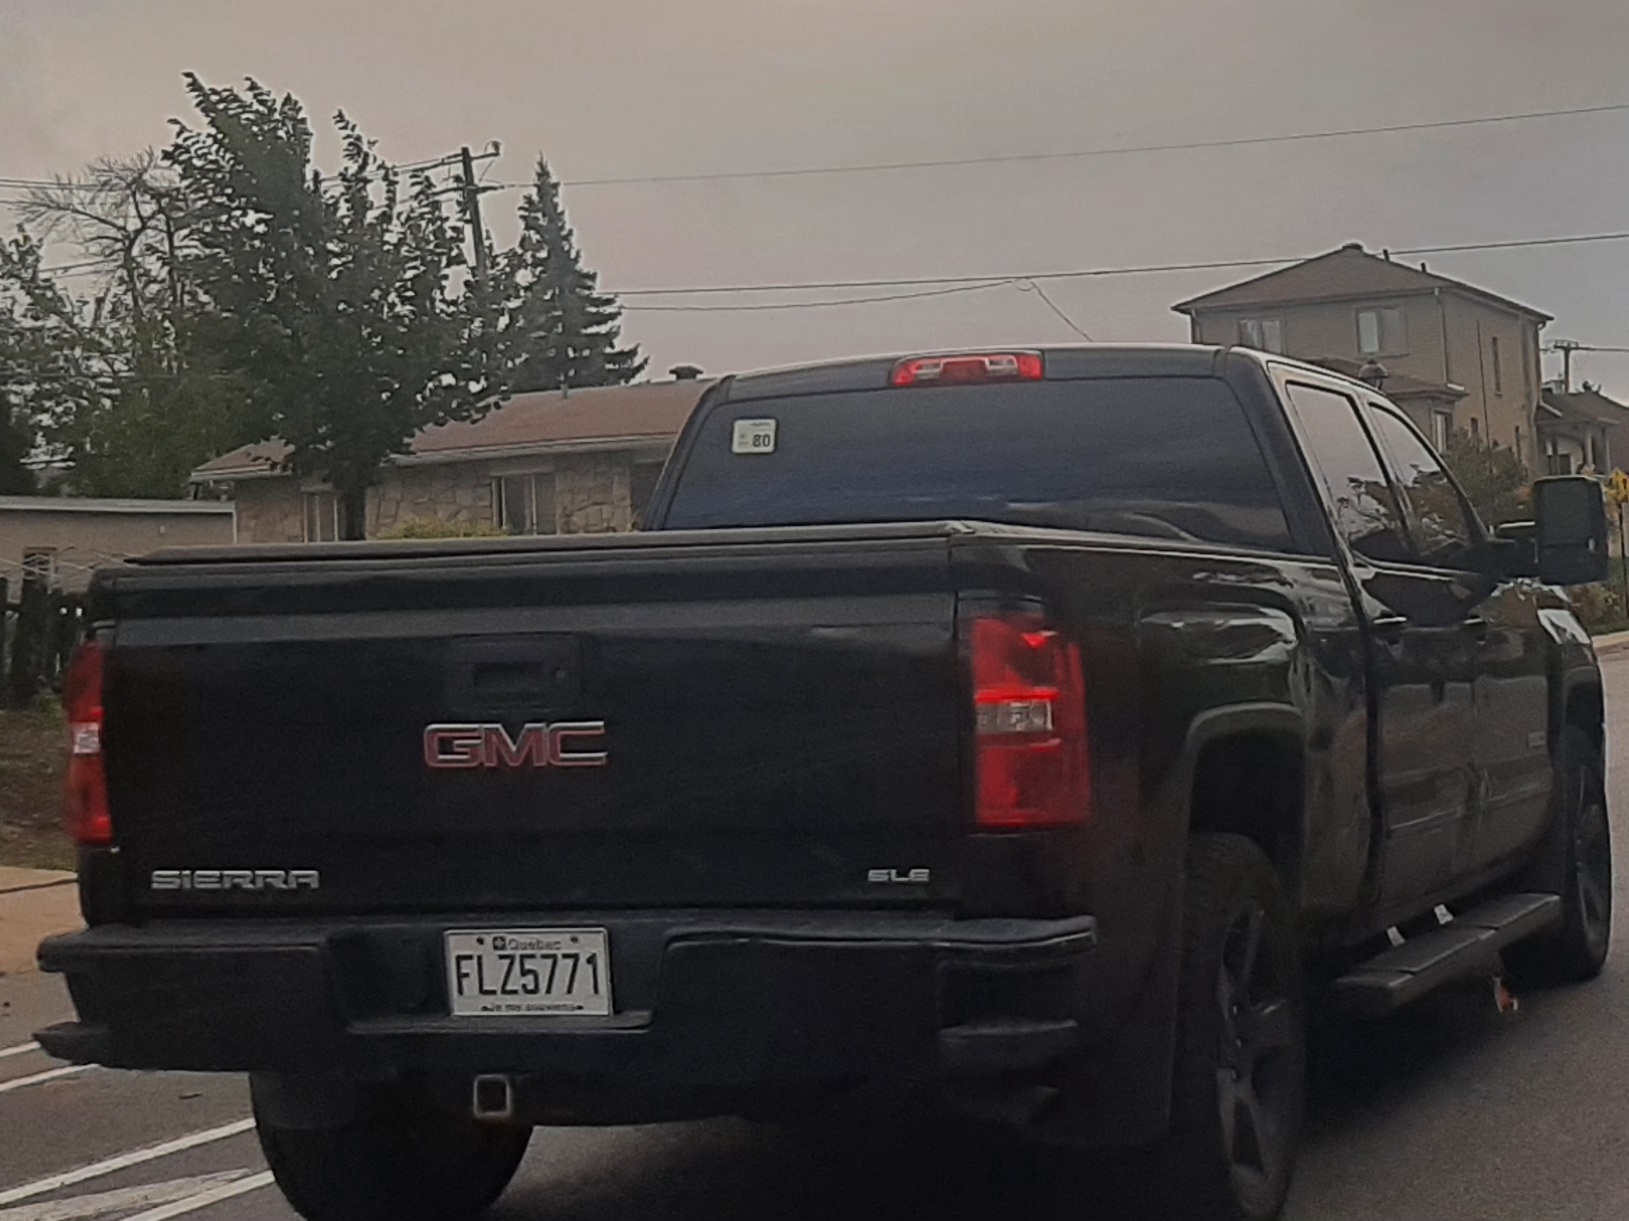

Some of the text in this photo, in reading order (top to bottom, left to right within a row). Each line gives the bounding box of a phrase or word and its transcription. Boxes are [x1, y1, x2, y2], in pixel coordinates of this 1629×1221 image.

[753, 433, 771, 448] 80
[424, 721, 608, 767] GMC
[151, 869, 320, 890] SIERRA
[867, 868, 930, 882] SLE
[455, 953, 600, 996] FLZ5771
